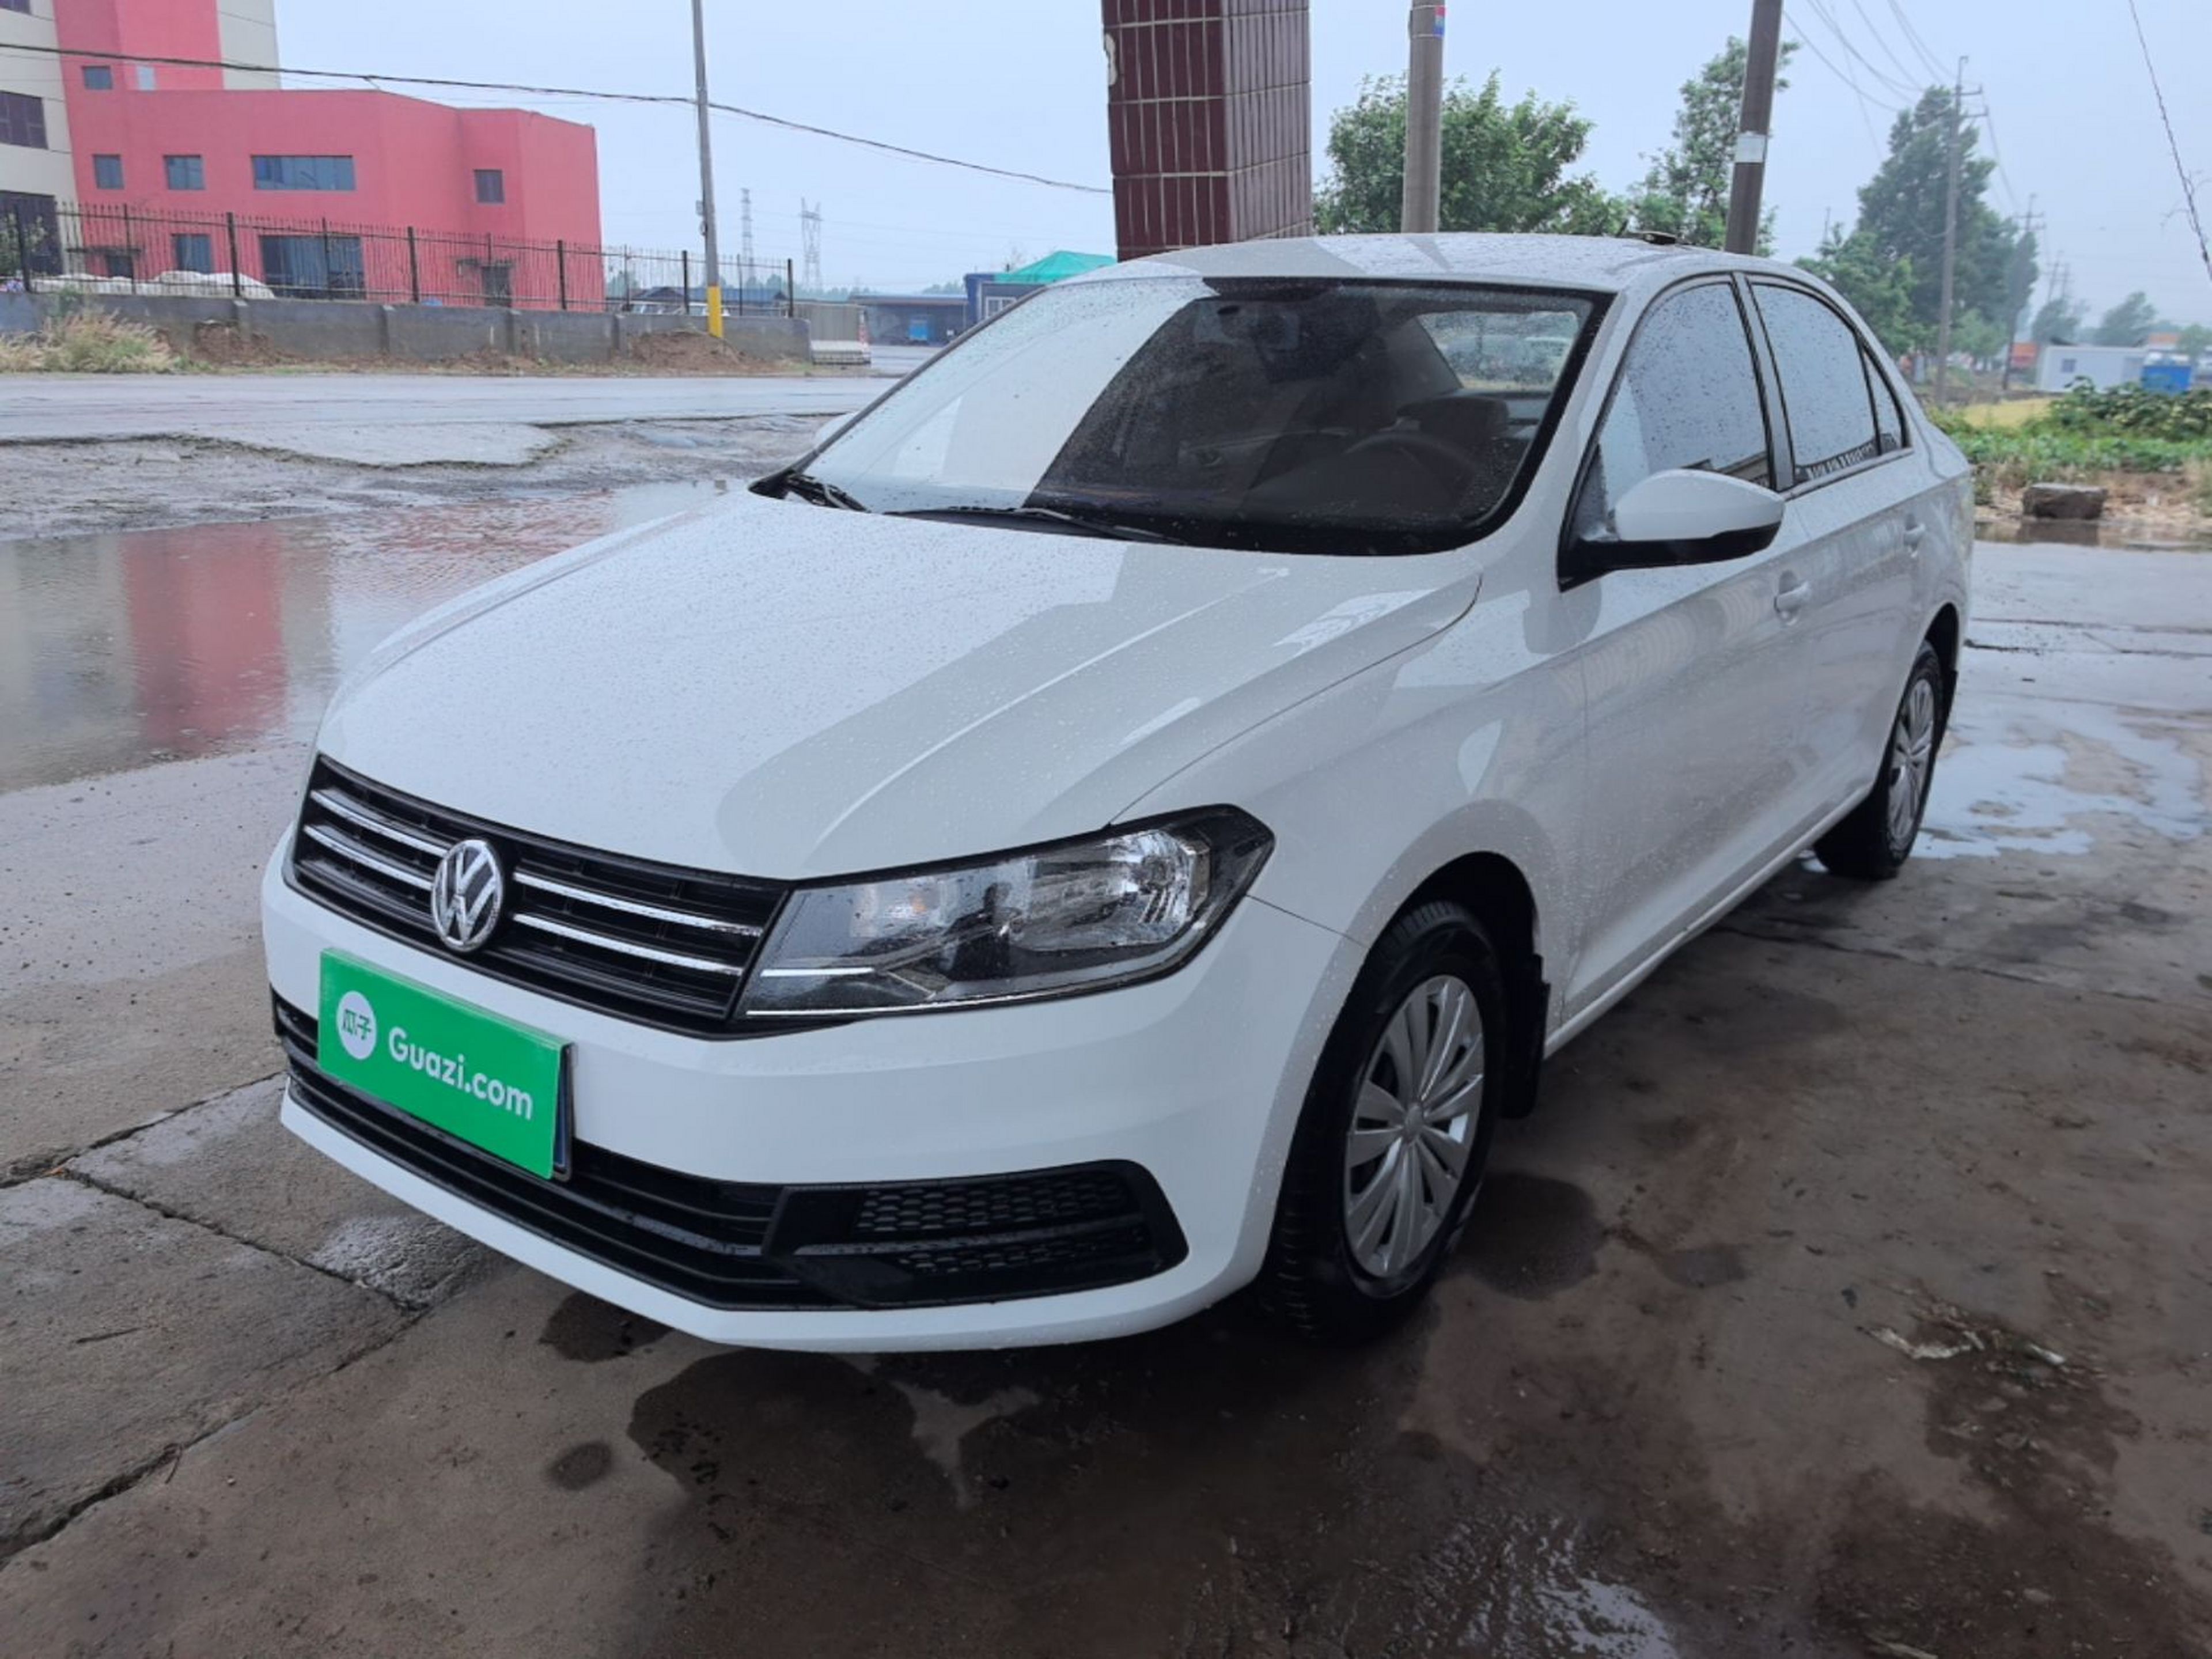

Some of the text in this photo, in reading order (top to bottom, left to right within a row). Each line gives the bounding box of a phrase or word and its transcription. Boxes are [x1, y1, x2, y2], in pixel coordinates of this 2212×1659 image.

[434, 842, 501, 946] VW
[342, 1008, 372, 1040] 瓜子
[388, 1027, 533, 1121] Guazi.com
